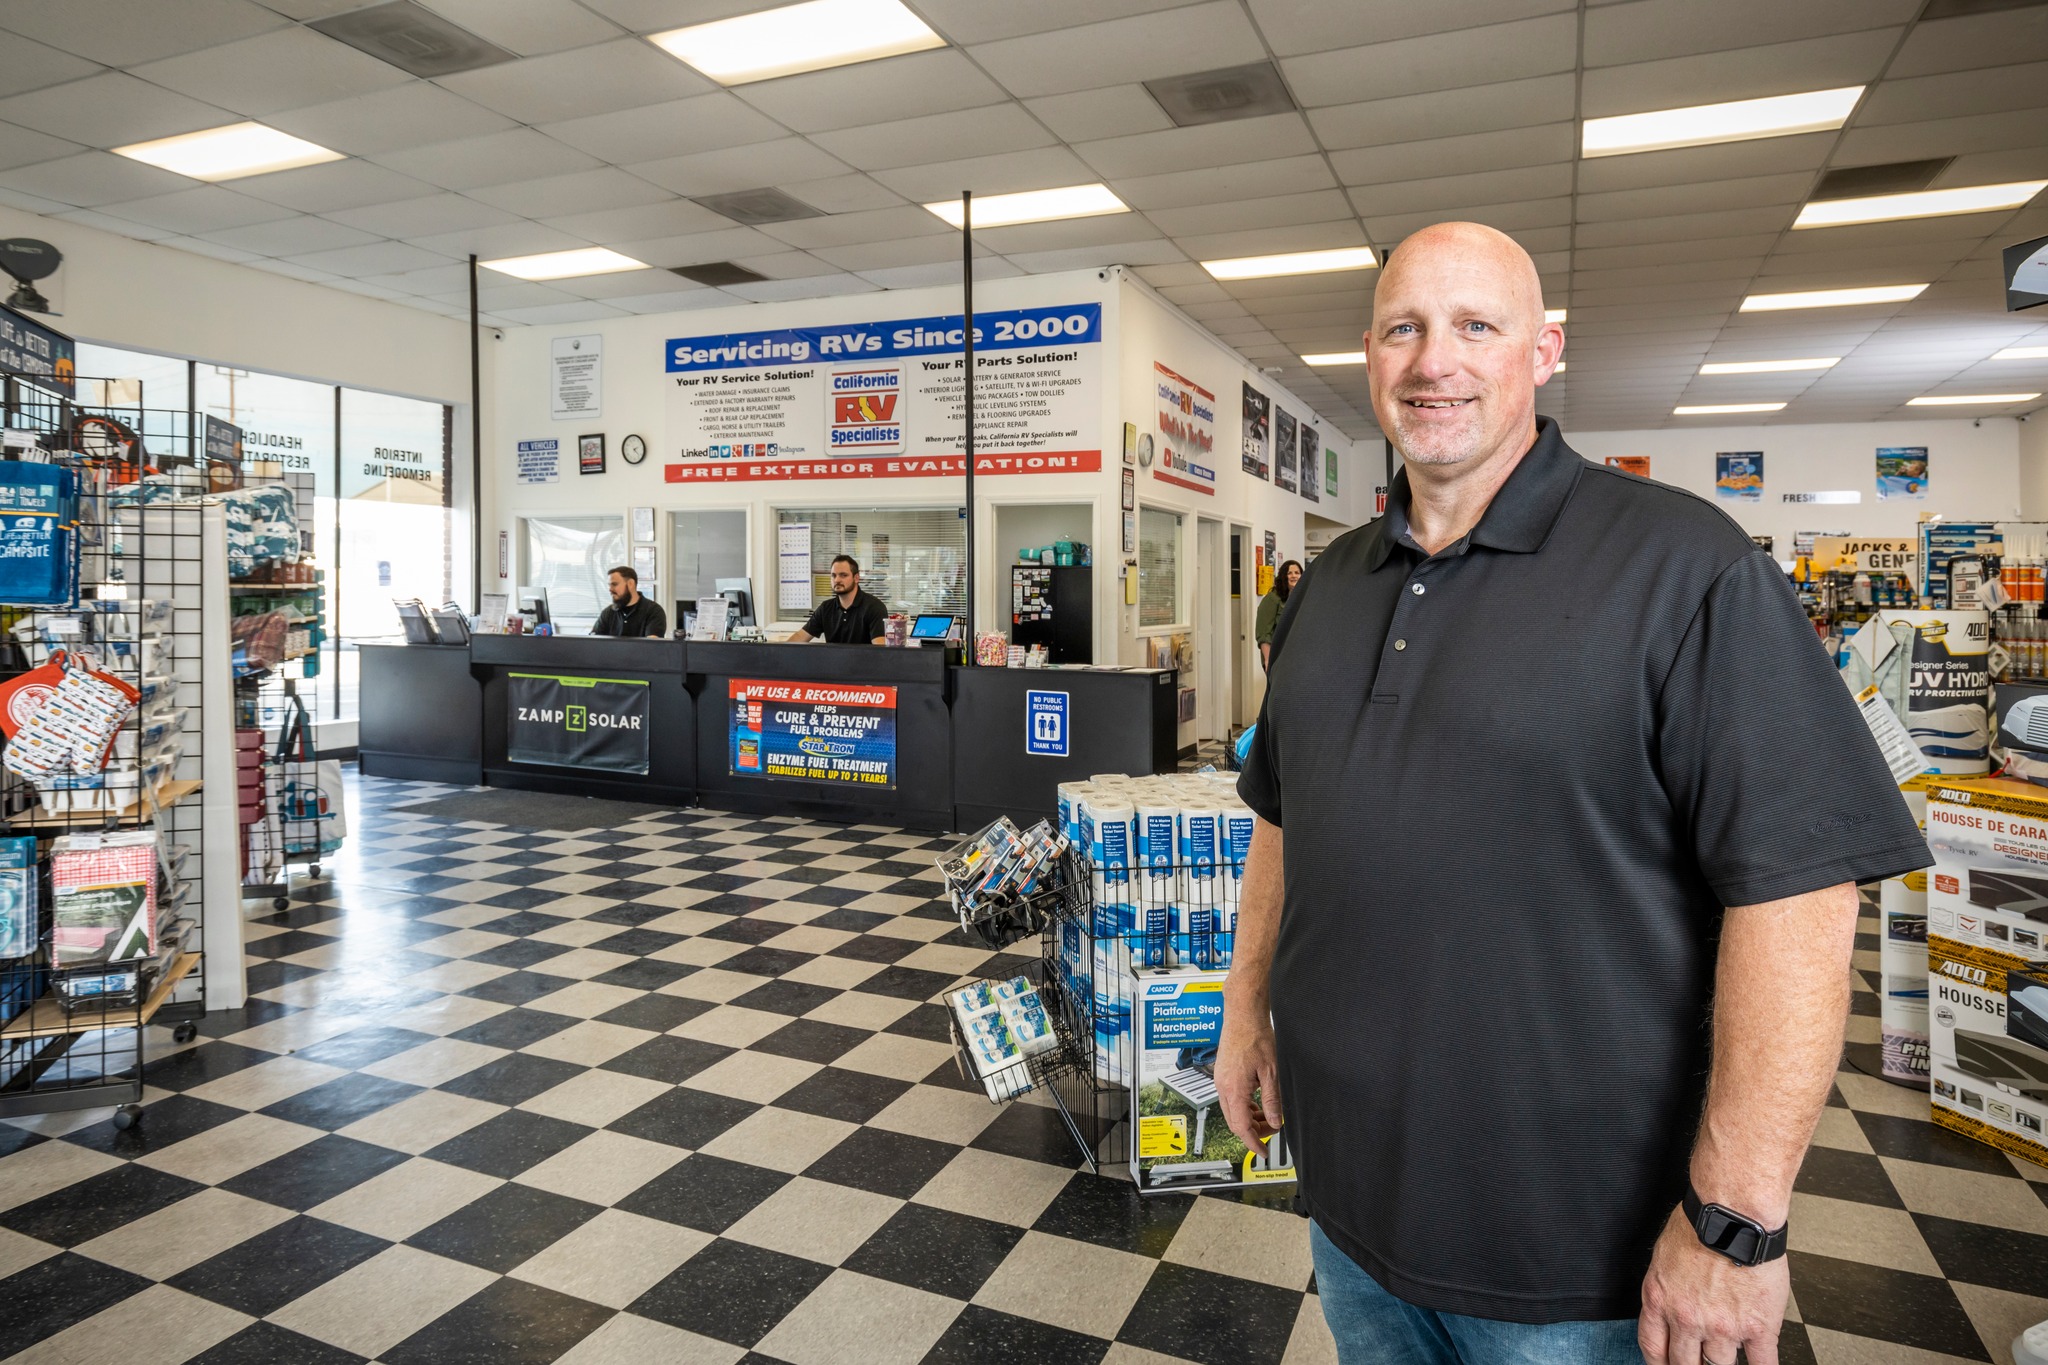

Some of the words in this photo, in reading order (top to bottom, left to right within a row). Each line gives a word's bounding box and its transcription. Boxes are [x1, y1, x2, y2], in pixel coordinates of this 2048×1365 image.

[674, 339, 810, 365] Servicing
[820, 333, 882, 355] RVs
[892, 328, 984, 350] Since
[994, 315, 1089, 342] 2000
[922, 361, 951, 371] Your
[977, 356, 1012, 368] Parts
[1016, 352, 1078, 365] Solution!
[676, 378, 700, 387] Your
[703, 376, 718, 384] RV
[722, 373, 760, 384] Service
[764, 370, 814, 381] Solution!
[834, 374, 898, 389] California
[1000, 372, 1035, 380] GENERATOR
[985, 382, 1015, 390] SATELLITE,
[1049, 378, 1081, 386] UPGRADES
[835, 394, 898, 423] RV
[832, 427, 900, 444] Specialists
[1031, 431, 1063, 439] Specialists
[1016, 440, 1046, 448] together!
[682, 448, 708, 457] Linked
[682, 468, 738, 478] FREE
[750, 464, 874, 476] EXTERIOR
[887, 456, 1078, 472] EVALUATION!
[1783, 494, 1816, 502] FRESH
[0, 544, 50, 558] CAMPSITE
[1841, 543, 1892, 555] JACKS
[1946, 661, 1969, 670] Series
[747, 685, 765, 696] WE
[767, 687, 790, 699] USE
[792, 688, 801, 699] &
[805, 689, 885, 704] RECOMMEND
[814, 705, 836, 713] HELPS
[518, 707, 564, 723] ZAMP
[589, 713, 640, 730] SOLAR
[775, 711, 806, 724] CURE
[809, 713, 819, 725] &
[823, 714, 880, 729] PREVENT
[790, 725, 810, 735] FUEL
[813, 727, 863, 738] PROBLEMS
[801, 741, 826, 752] STAR
[827, 742, 855, 754] TRON
[767, 753, 805, 766] ENZYME
[808, 756, 829, 768] FUEL
[833, 758, 888, 773] TREATMENT
[767, 765, 807, 776] STABILIZES
[808, 768, 826, 778] FUEL
[828, 770, 839, 779] UP
[841, 771, 850, 780] TO
[853, 772, 858, 781] 2
[861, 773, 887, 784] YEARS!
[1938, 789, 1971, 804] ADCO
[1933, 810, 1982, 829] HOUSSE
[1988, 820, 2005, 833] DE
[2010, 824, 2048, 841] CARA
[1949, 845, 1966, 855] Tyvek
[2005, 854, 2028, 862] HOUSSE
[1938, 960, 1987, 985] ADCO
[1940, 985, 2006, 1018] HOUSSE
[1153, 1006, 1196, 1016] Platform
[1198, 1005, 1221, 1015] Step
[1153, 1021, 1215, 1032] Marchepied
